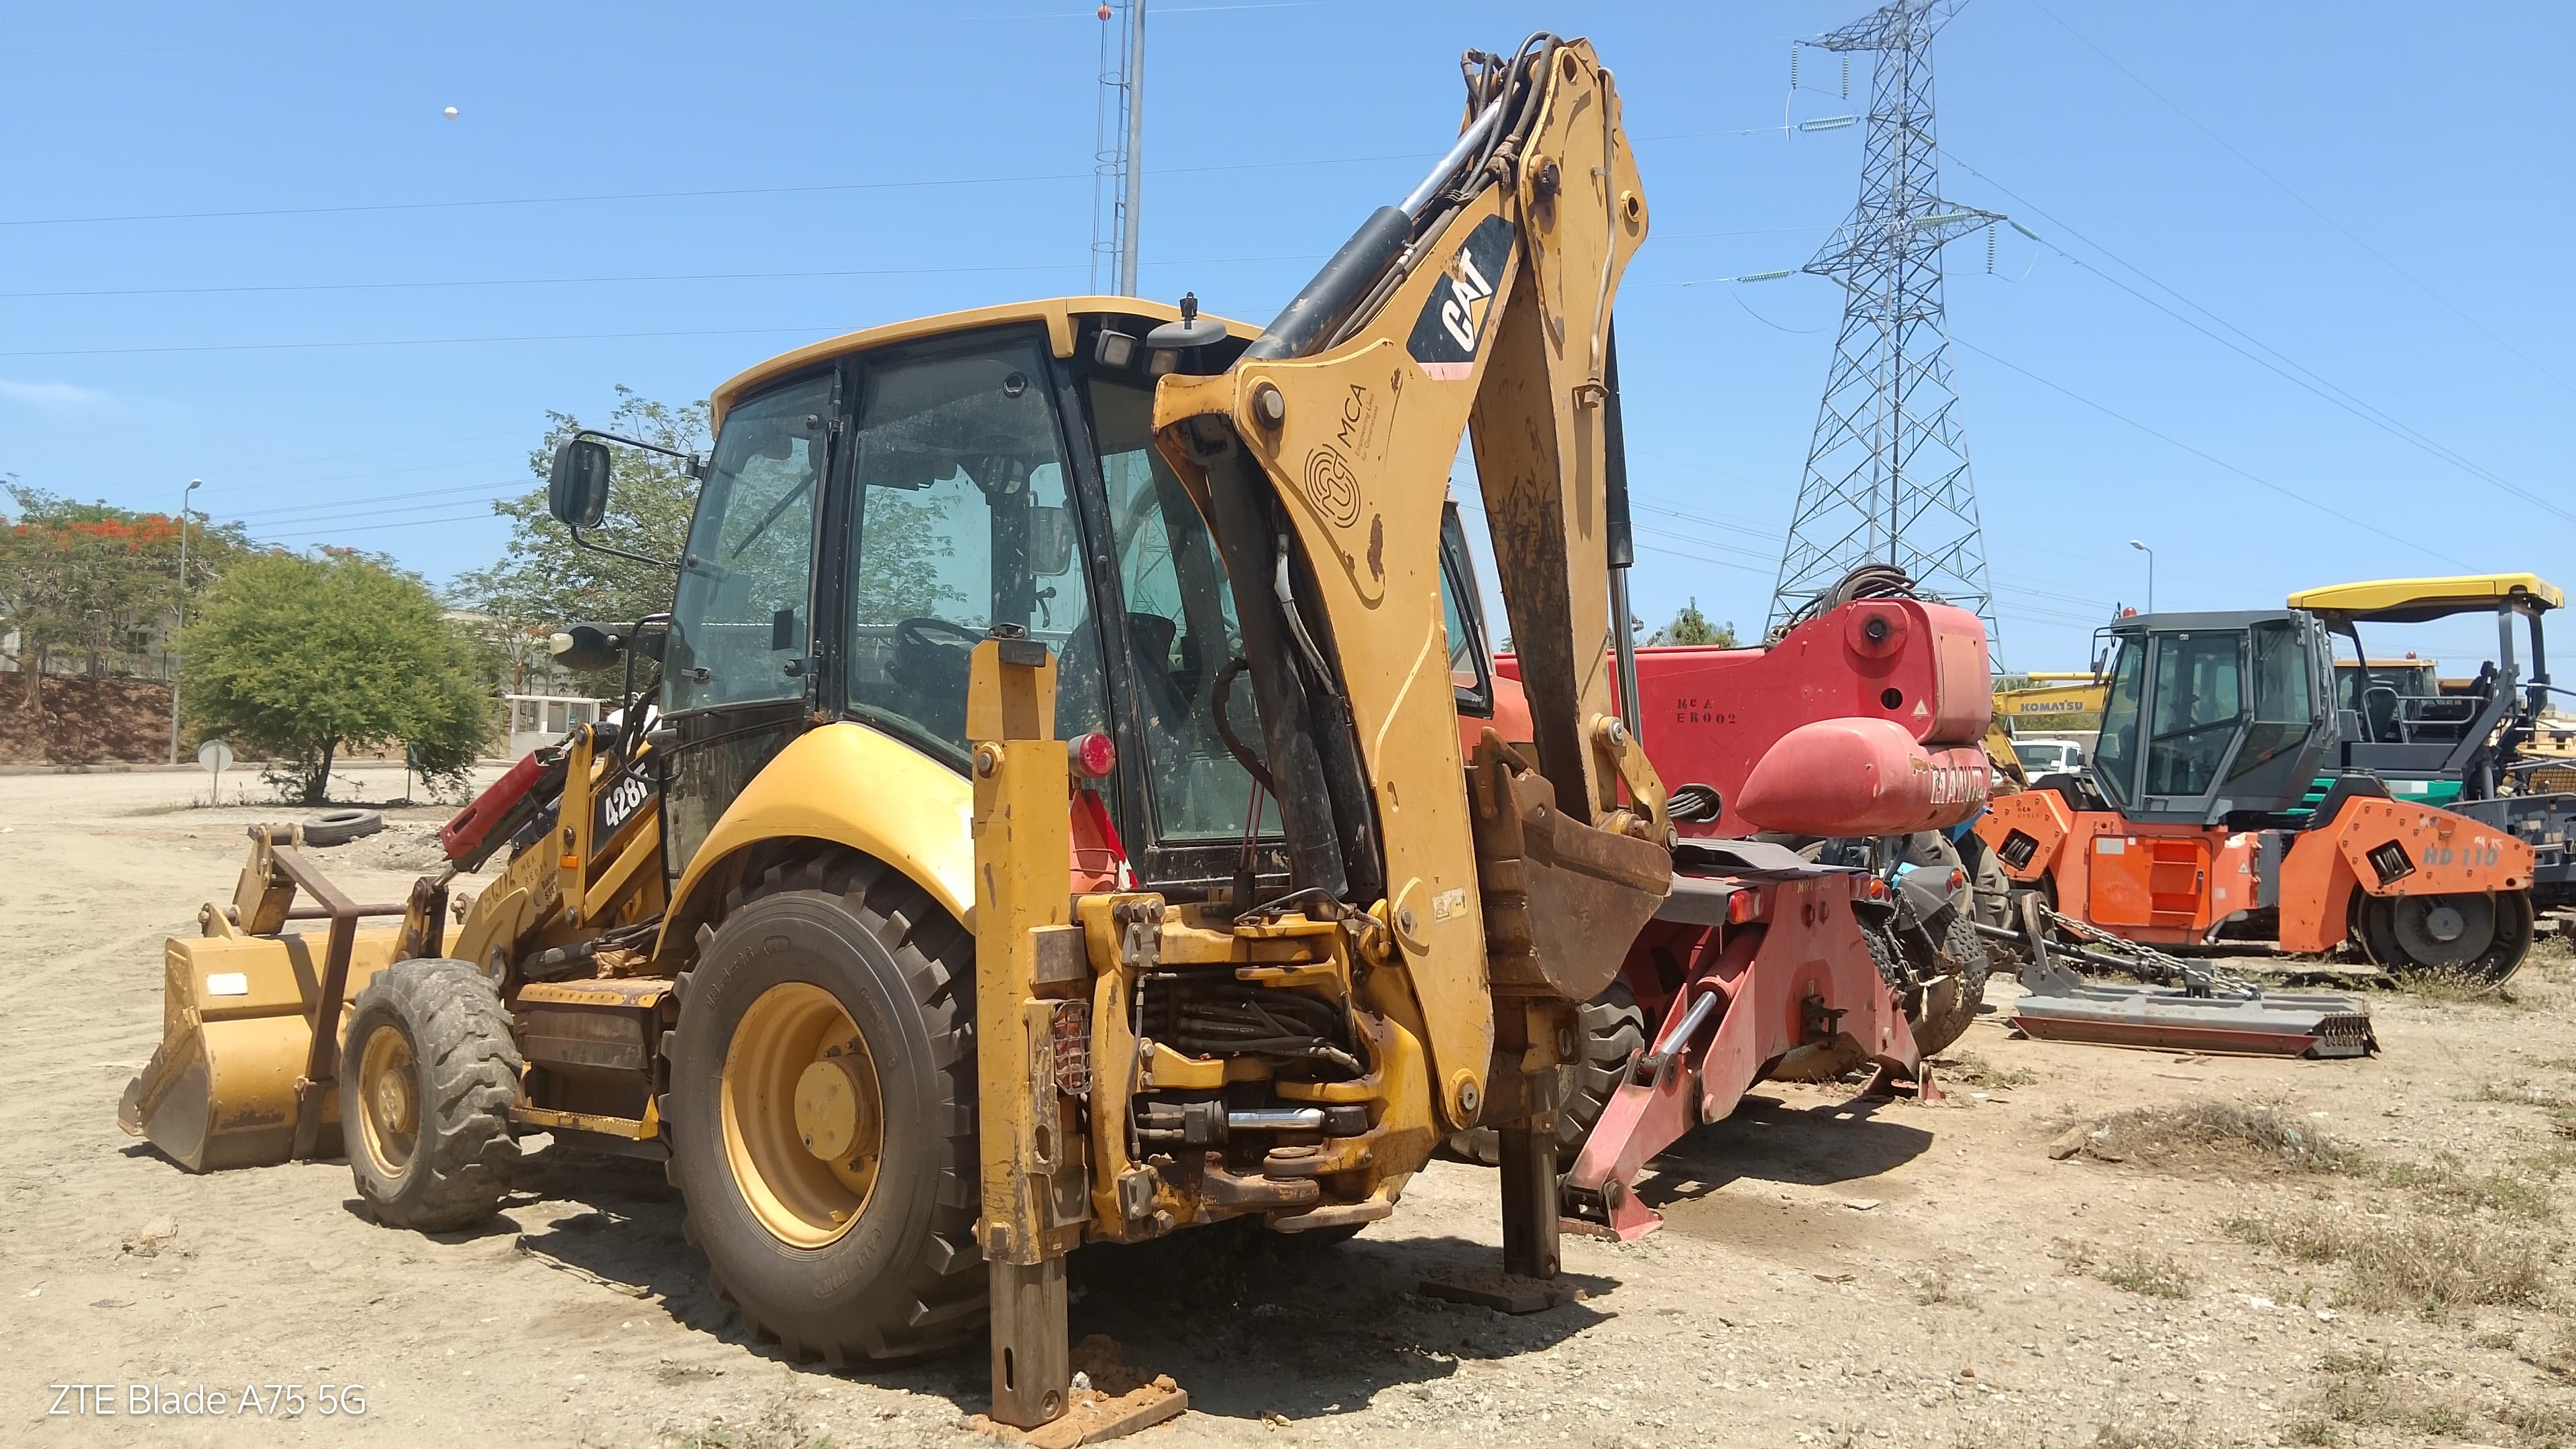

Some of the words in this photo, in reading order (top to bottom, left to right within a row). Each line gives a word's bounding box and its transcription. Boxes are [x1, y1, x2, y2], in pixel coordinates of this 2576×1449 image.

[1442, 246, 1493, 352] CAT
[1337, 384, 1366, 449] MCA
[1677, 712, 1735, 724] ER002
[2020, 701, 2084, 712] KOMATSU
[605, 761, 649, 826] 428F
[2422, 847, 2455, 866] HD
[2463, 847, 2499, 867] 110
